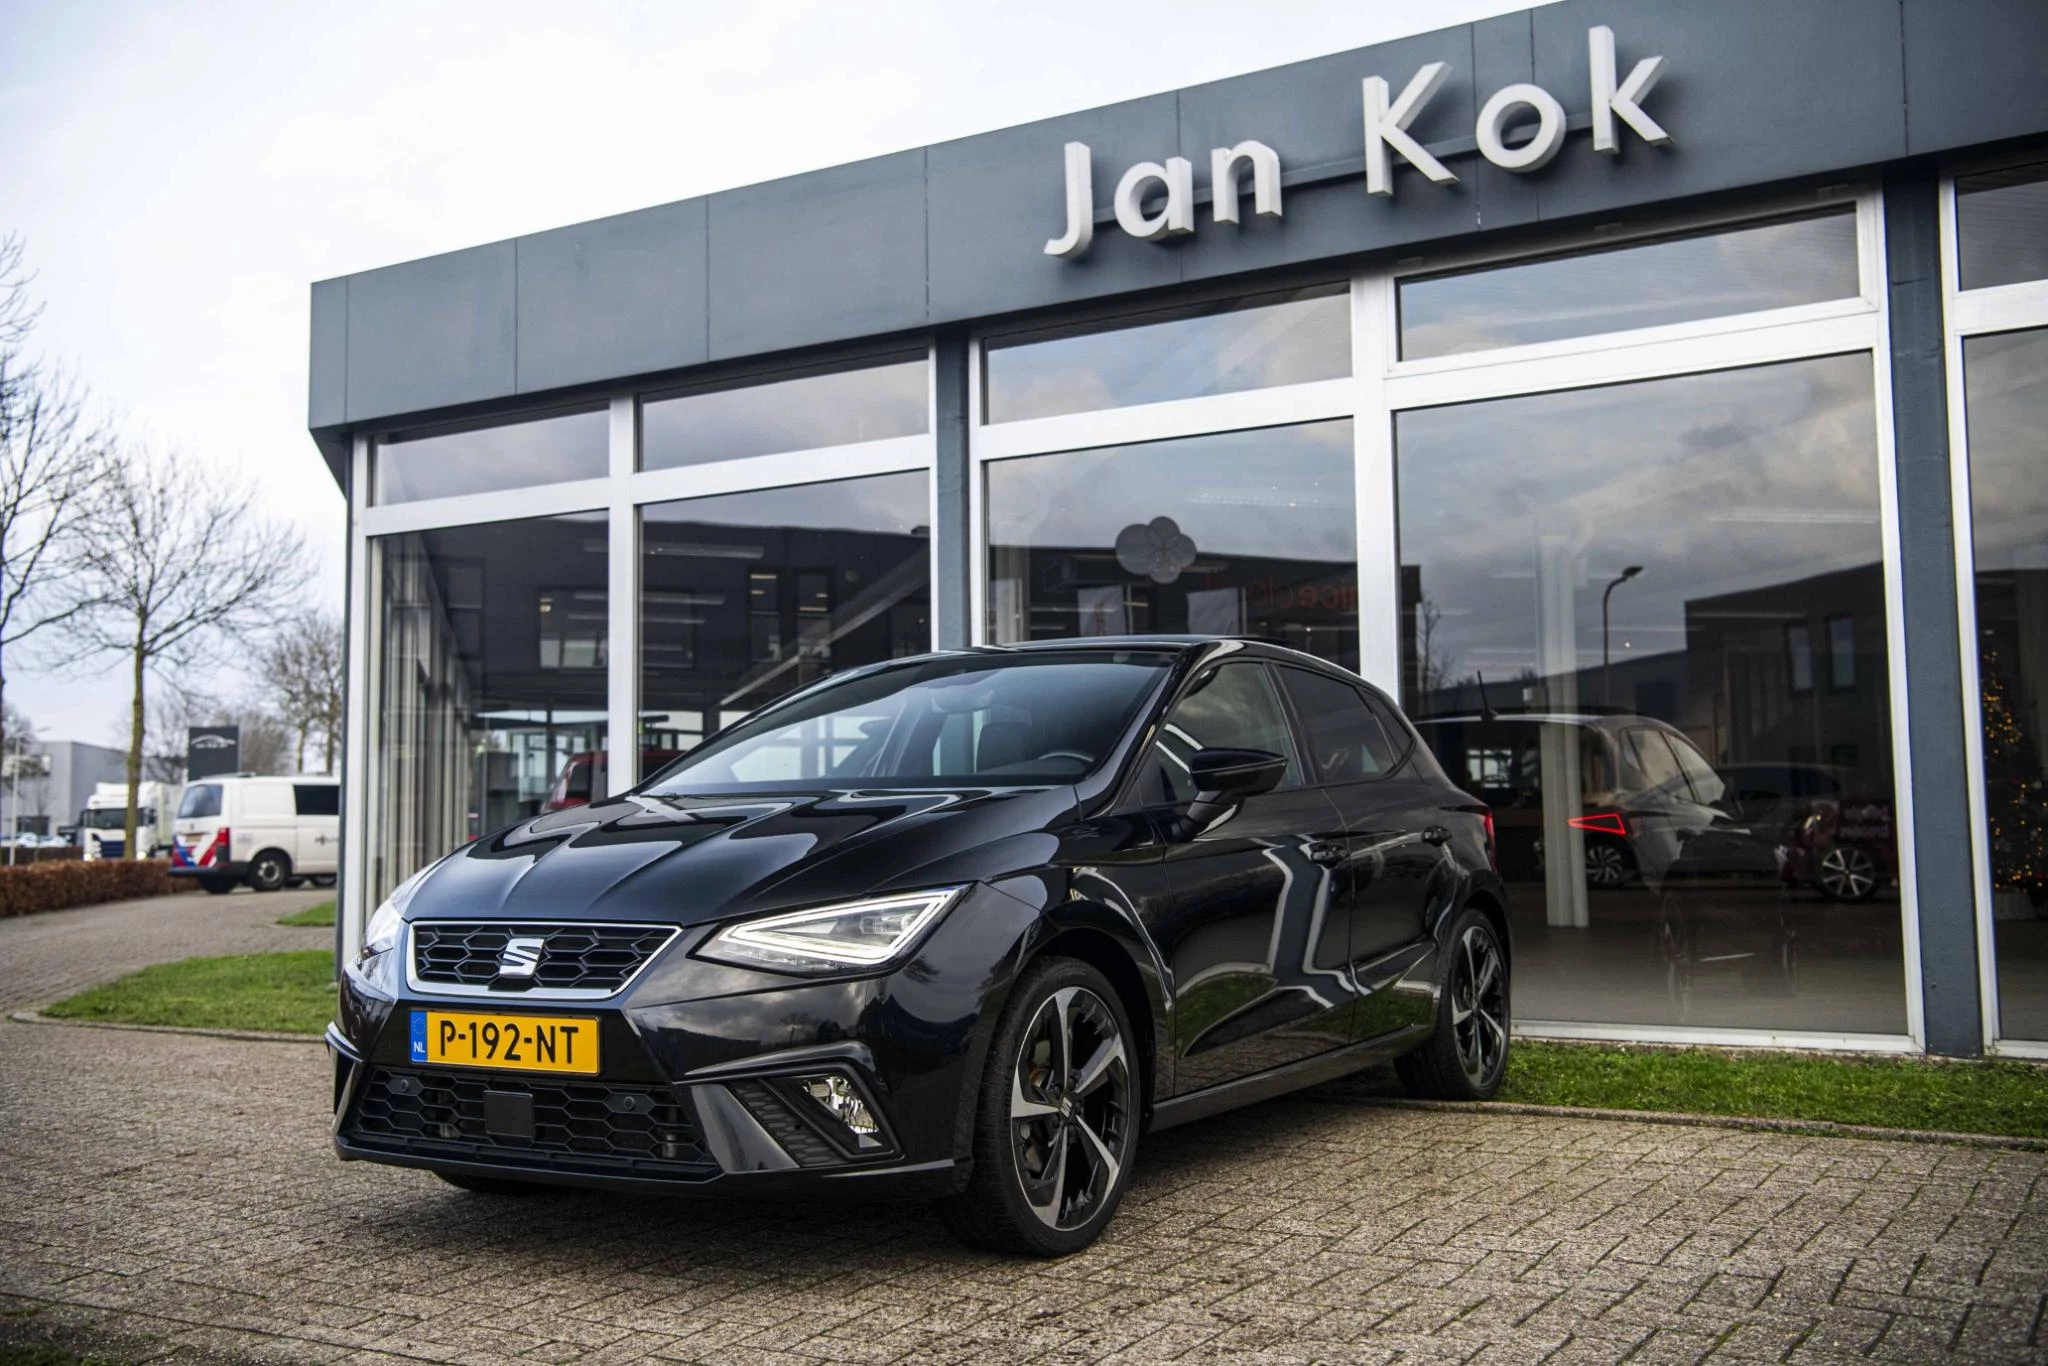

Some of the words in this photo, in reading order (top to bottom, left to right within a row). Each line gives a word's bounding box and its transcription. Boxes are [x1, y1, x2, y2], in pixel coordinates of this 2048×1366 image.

[1044, 139, 1282, 259] Jan
[1362, 25, 1673, 198] Kok
[413, 1041, 426, 1054] NL
[440, 1020, 579, 1064] P-192-NT
